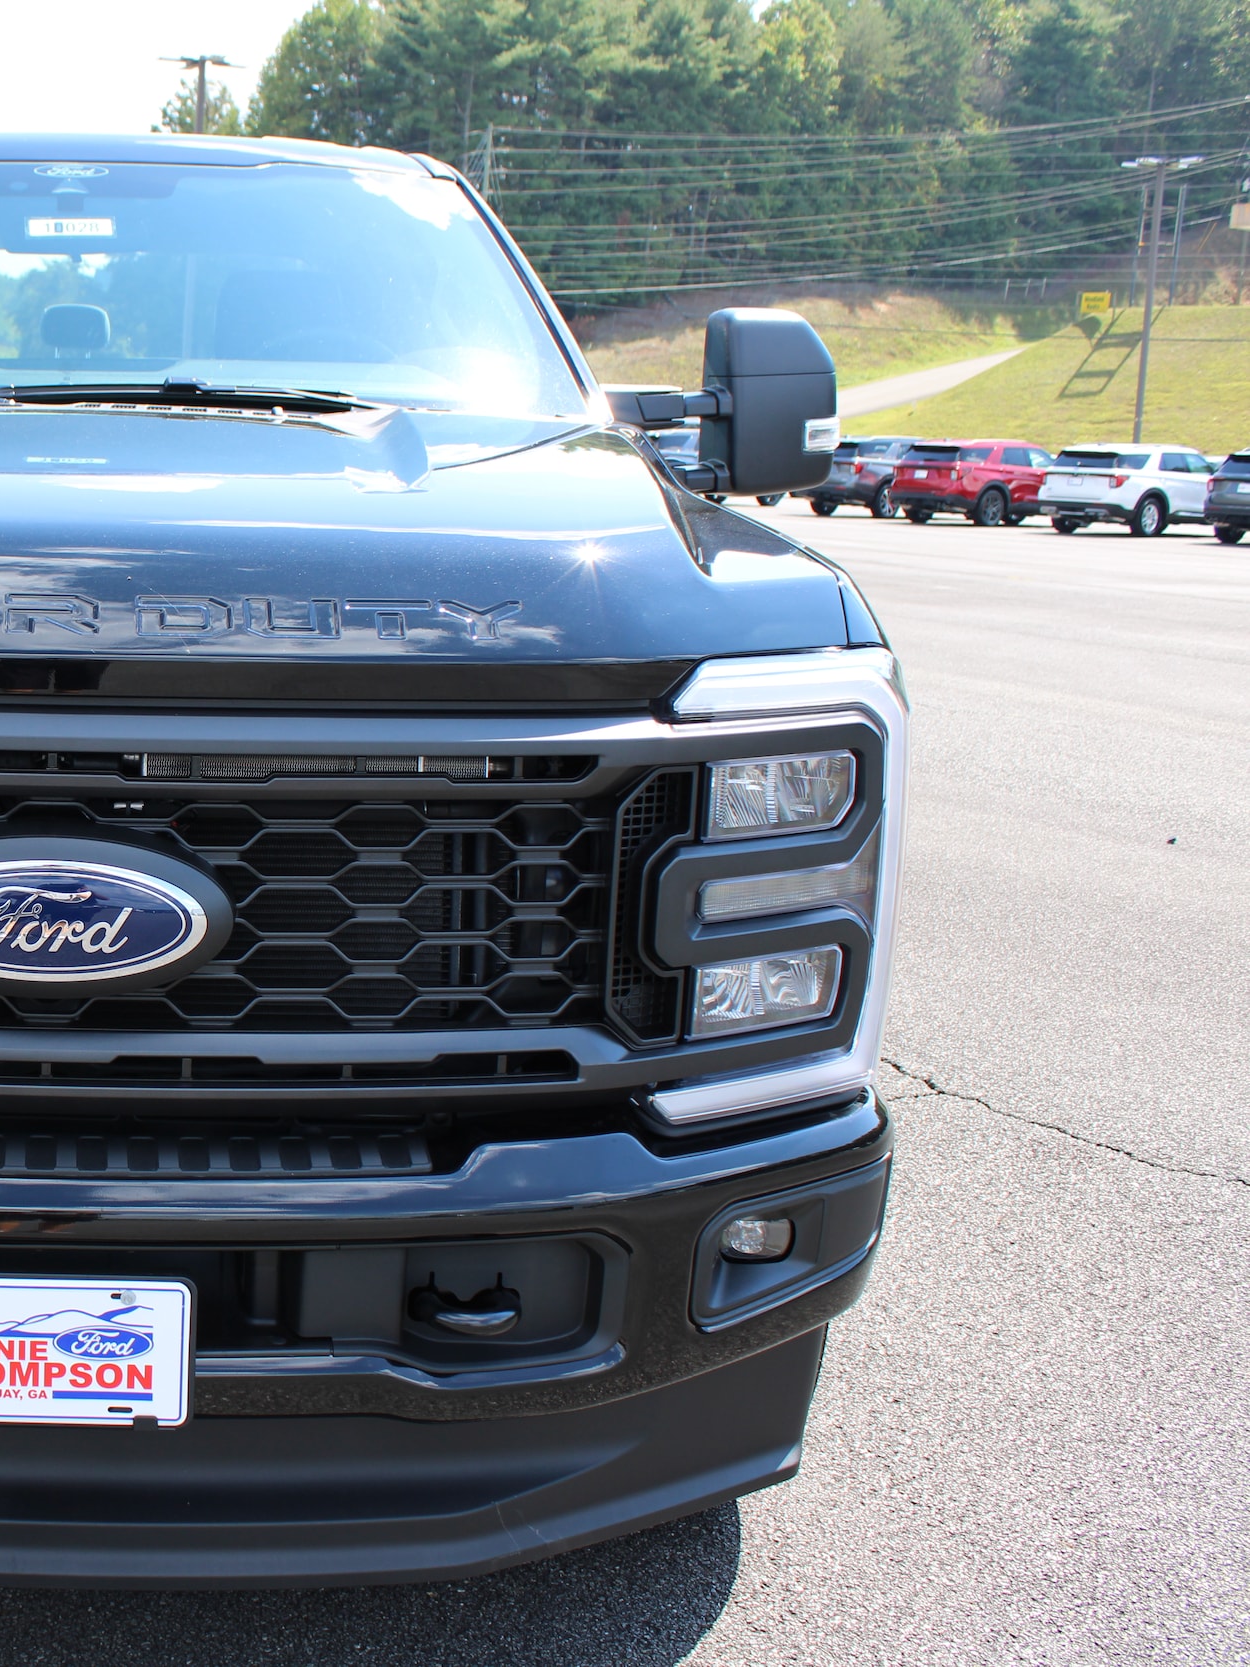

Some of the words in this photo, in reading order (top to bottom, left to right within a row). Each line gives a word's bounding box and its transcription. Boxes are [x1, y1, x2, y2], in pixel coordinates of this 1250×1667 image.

[134, 594, 524, 640] DUTY
[71, 1330, 134, 1357] Ford
[28, 1390, 48, 1400] GA
